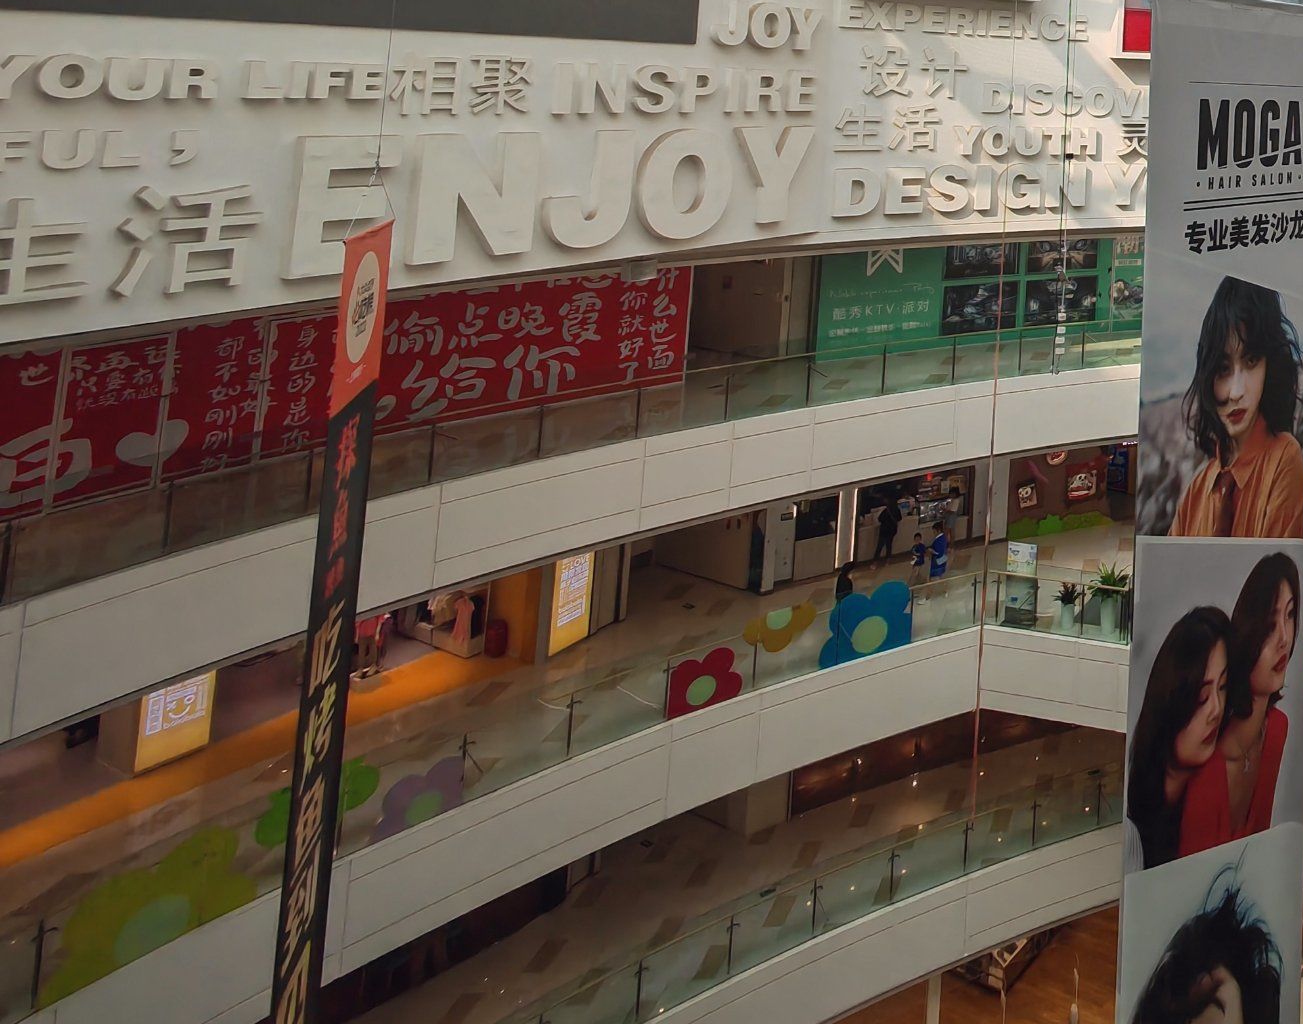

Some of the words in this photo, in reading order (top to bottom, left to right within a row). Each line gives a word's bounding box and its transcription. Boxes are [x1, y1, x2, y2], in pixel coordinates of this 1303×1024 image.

[712, 0, 826, 50] JOY
[838, 0, 1089, 42] EXPERIENCE
[241, 59, 388, 100] LIFE
[389, 53, 533, 116] 相聚
[550, 61, 817, 115] INSPIRE
[861, 44, 969, 100] 设计
[834, 103, 944, 153] 生活
[954, 123, 1098, 157] YOUTH
[1196, 98, 1302, 170] MOGA
[280, 126, 817, 280] ENJOY
[831, 162, 1087, 218] DESIGN
[1208, 175, 1242, 190] HAIR
[1251, 171, 1293, 187] SALON
